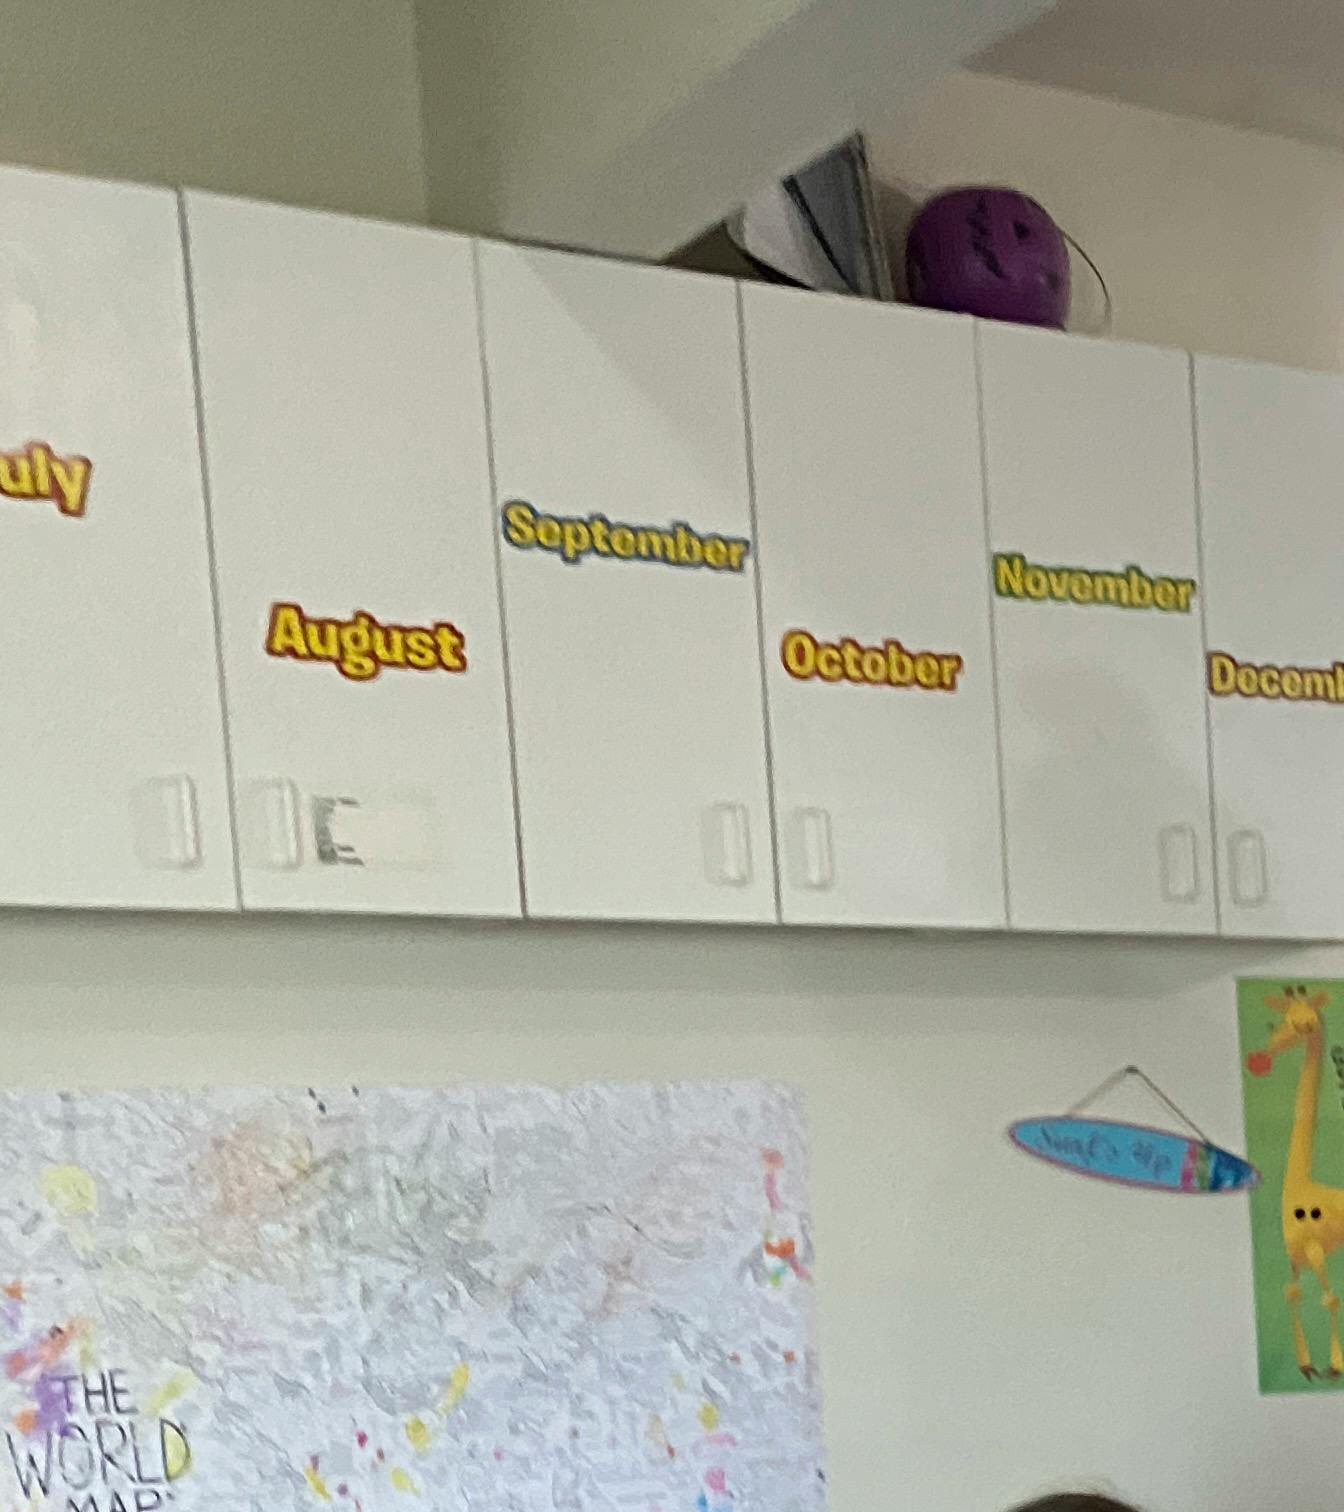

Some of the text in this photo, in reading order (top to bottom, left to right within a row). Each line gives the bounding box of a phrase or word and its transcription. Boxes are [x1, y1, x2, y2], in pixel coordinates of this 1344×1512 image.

[504, 501, 745, 570] September
[992, 553, 1195, 611] November
[264, 601, 467, 682] August
[780, 628, 962, 691] October
[48, 1367, 138, 1414] THE
[5, 1418, 192, 1499] WORLD
